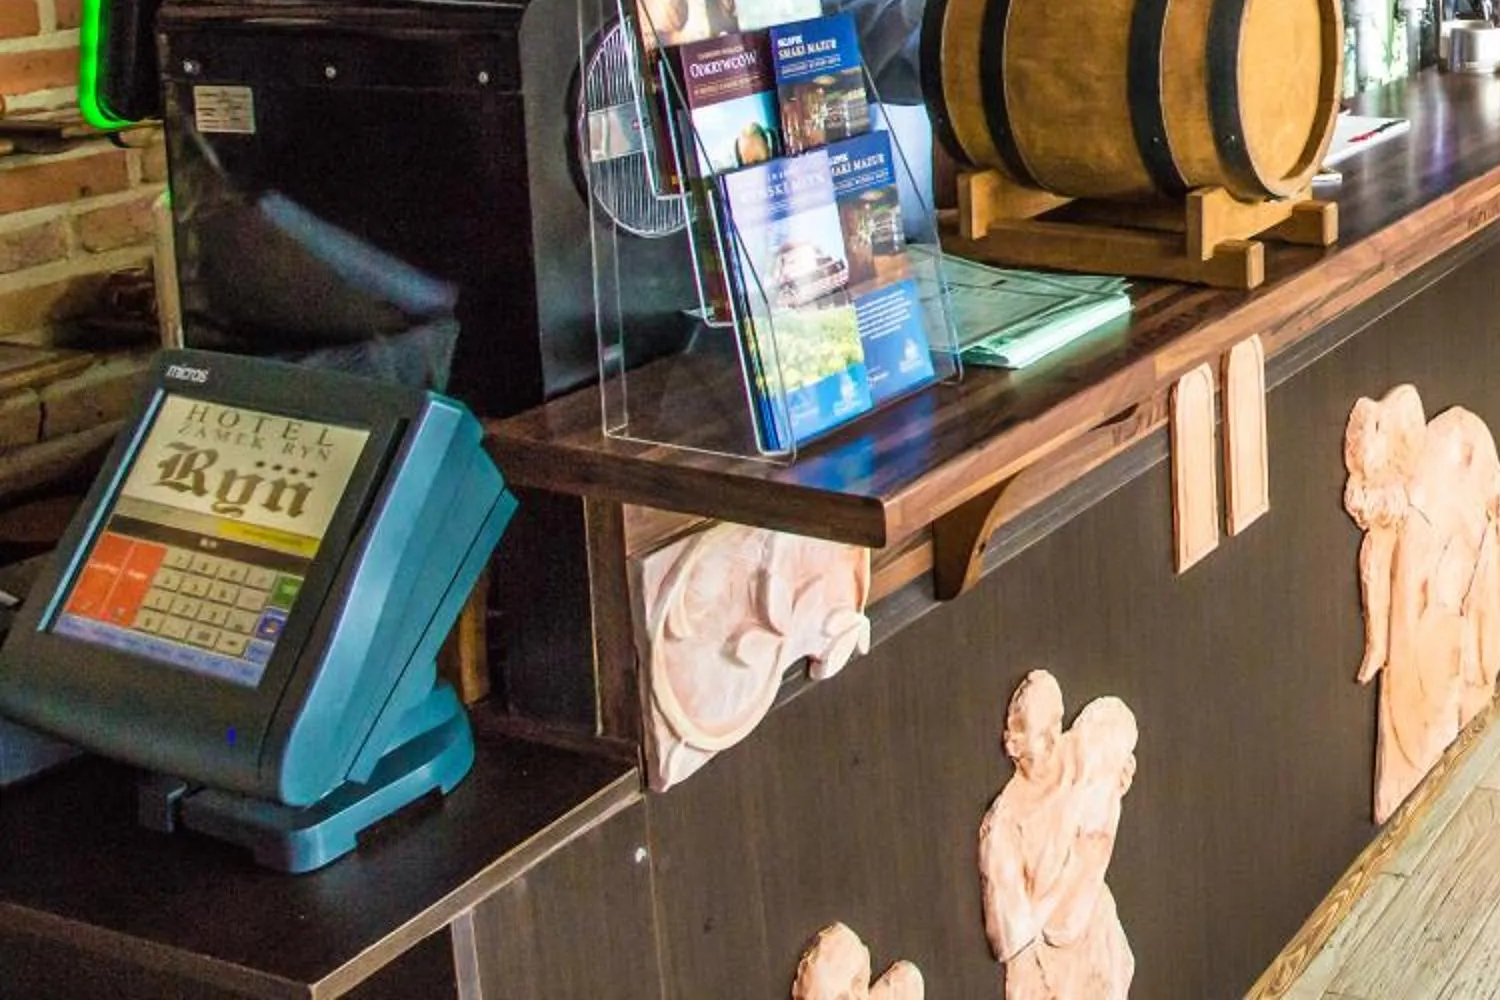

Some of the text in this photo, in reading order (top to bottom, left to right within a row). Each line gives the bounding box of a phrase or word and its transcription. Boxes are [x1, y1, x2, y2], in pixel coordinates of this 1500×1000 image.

[165, 363, 210, 383] micros
[177, 424, 333, 463] ZAMEK RYN
[185, 402, 335, 448] HOTEL
